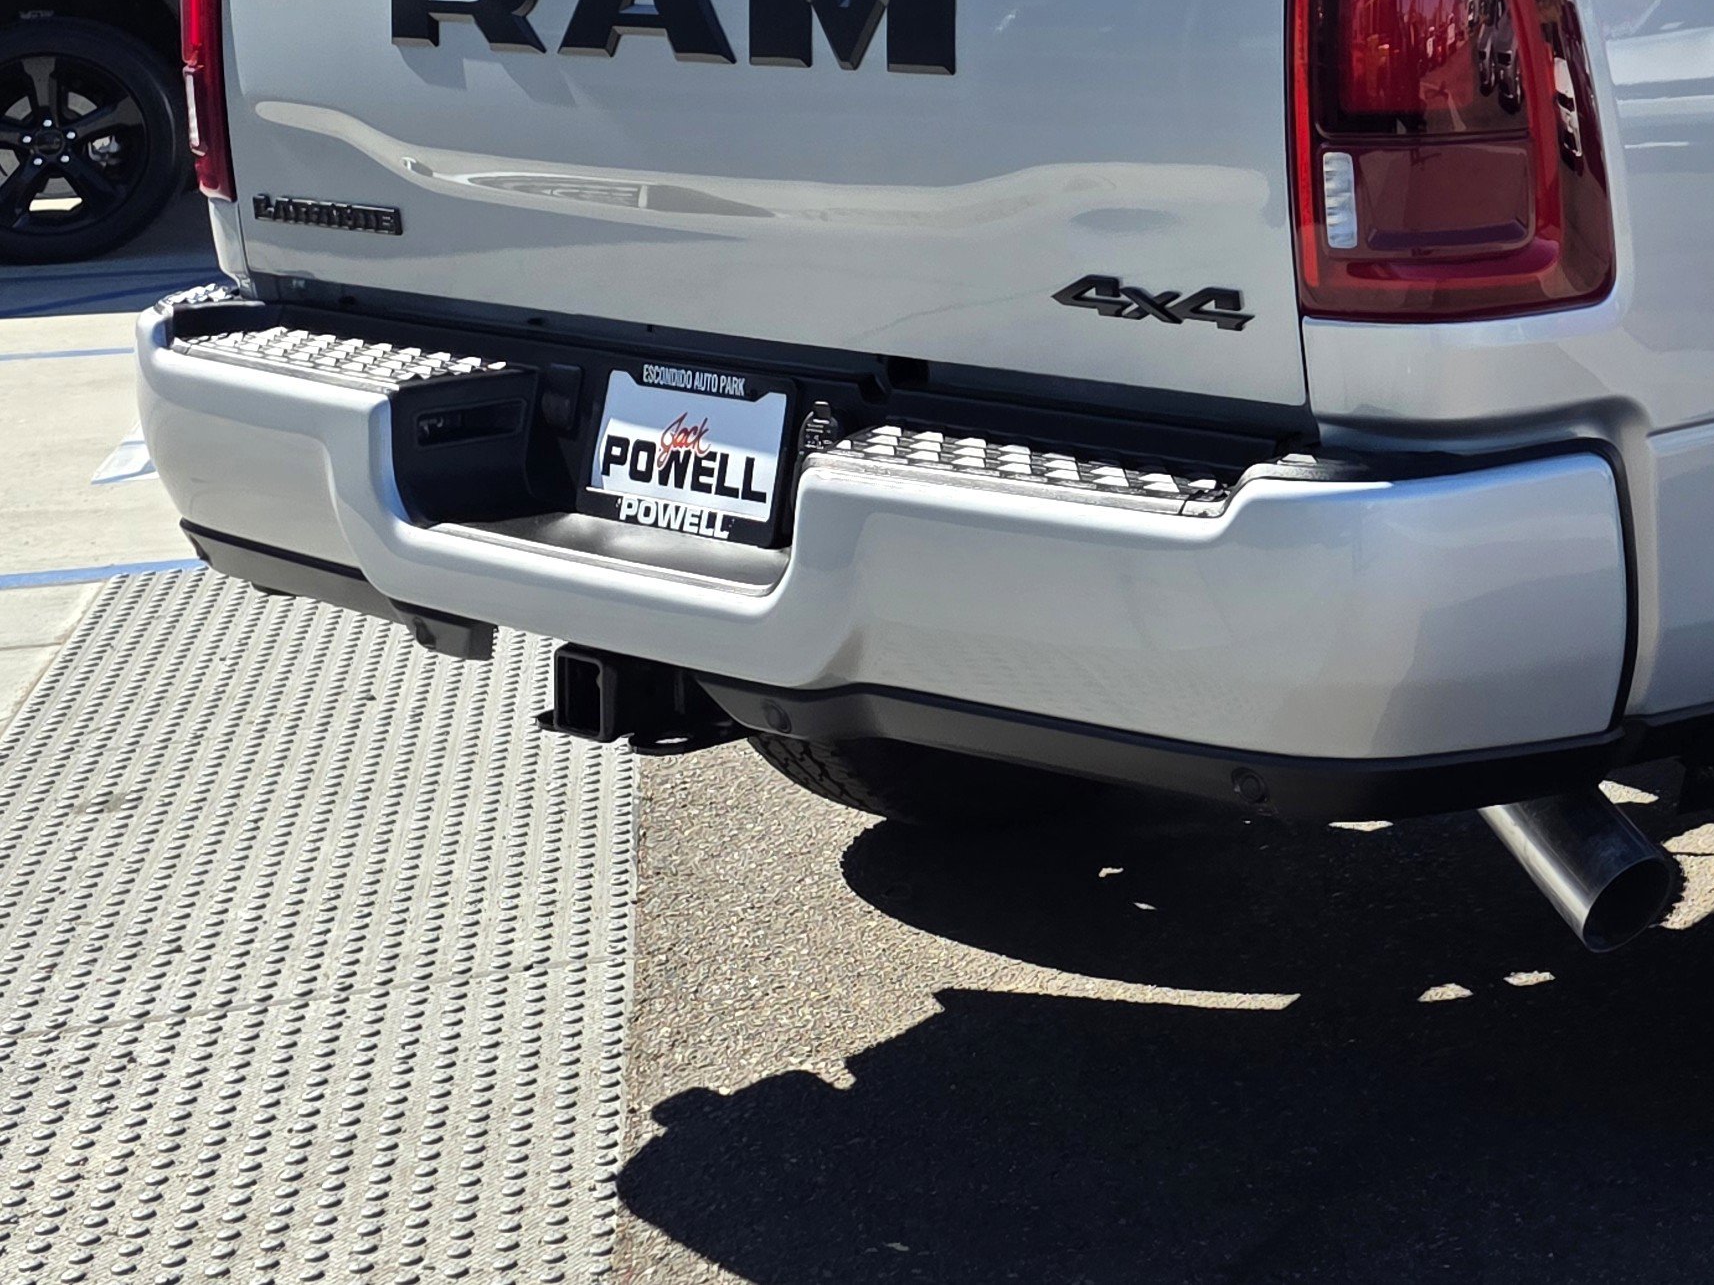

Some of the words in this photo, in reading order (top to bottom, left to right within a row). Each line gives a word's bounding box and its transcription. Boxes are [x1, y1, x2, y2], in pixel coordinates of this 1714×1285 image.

[643, 364, 693, 389] ESCONDIDO
[693, 371, 718, 393] AUTO
[719, 375, 746, 397] PARK
[656, 411, 712, 469] Jack
[601, 434, 767, 504] POWELL
[619, 497, 730, 539] POWELL
